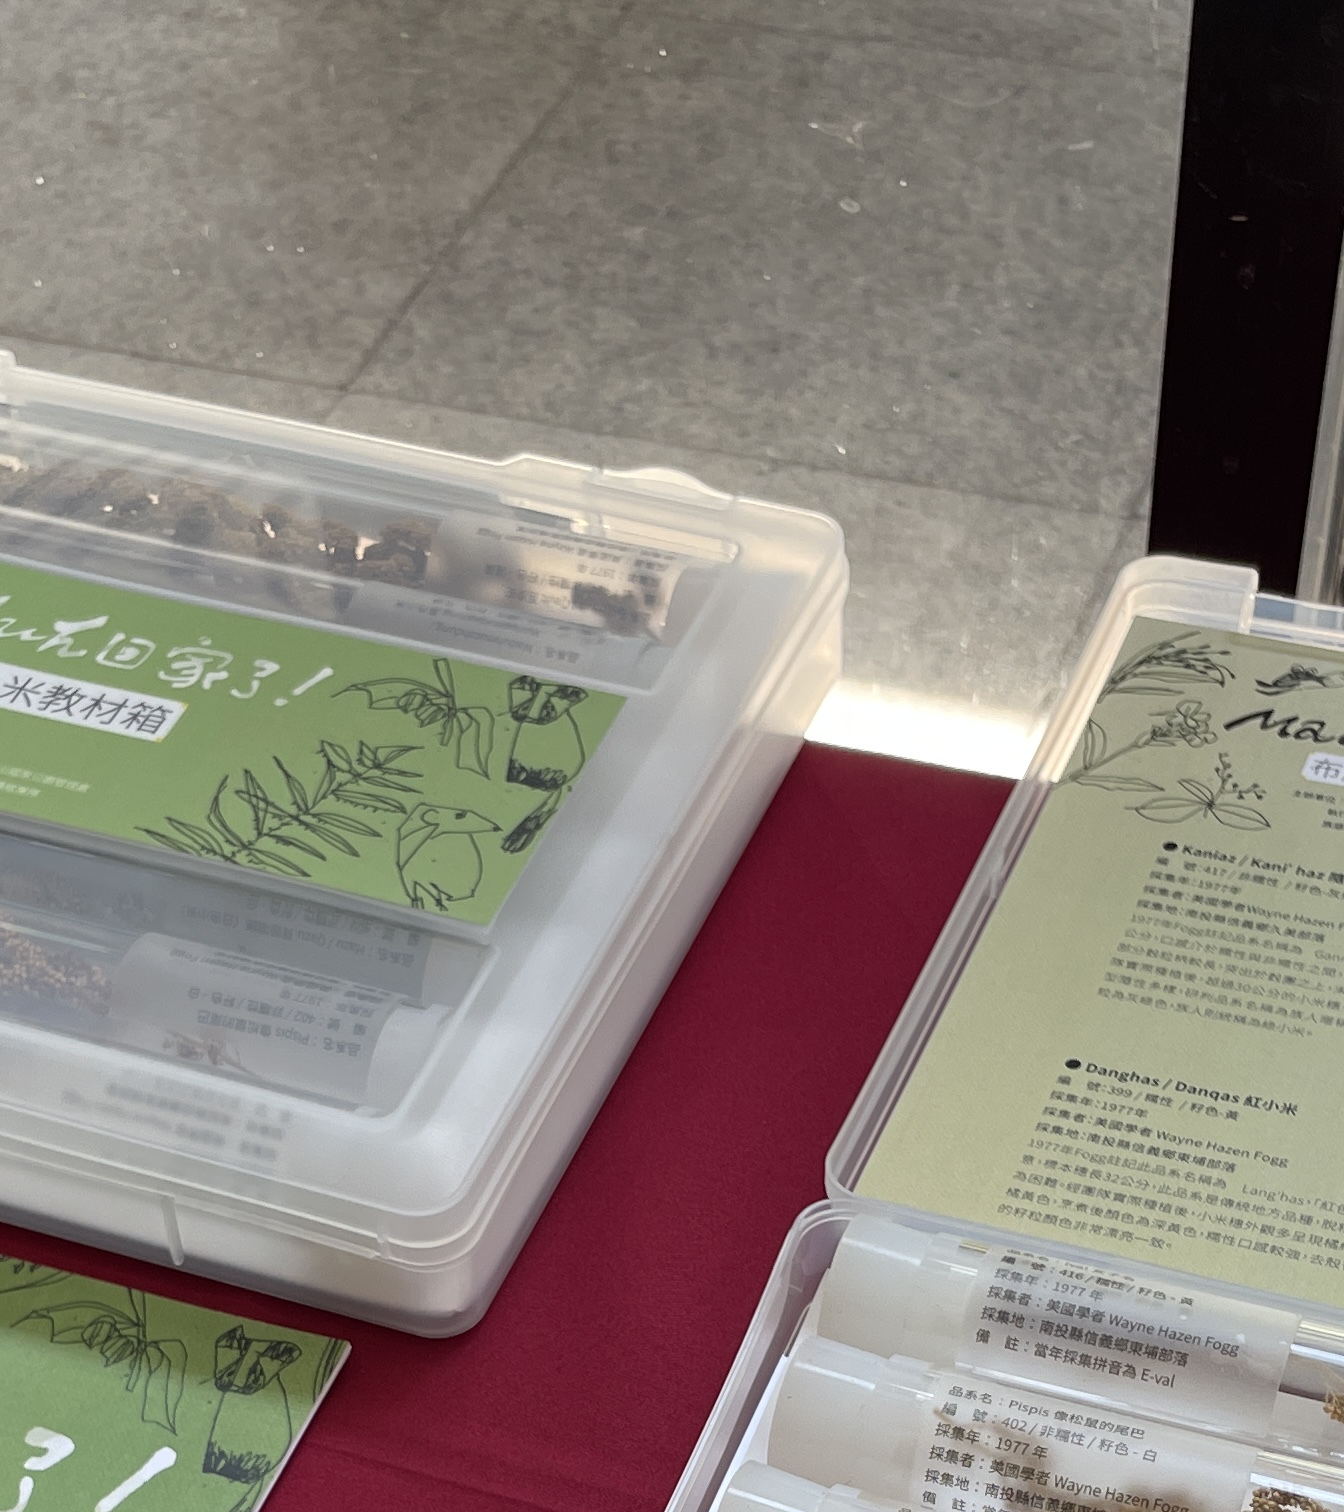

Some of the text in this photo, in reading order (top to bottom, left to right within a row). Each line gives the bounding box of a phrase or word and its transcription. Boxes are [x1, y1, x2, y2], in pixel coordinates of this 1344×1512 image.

[1083, 1060, 1299, 1117] Danghas Danqas 紅小米
[1109, 1311, 1155, 1335] Wayne
[1158, 1323, 1201, 1346] Hazen
[1205, 1335, 1239, 1358] Fogg
[1141, 1367, 1176, 1388] E-val
[1054, 1409, 1145, 1440] 像松鼠的尾巴
[1143, 1449, 1157, 1462] 白
[1055, 1474, 1102, 1498] Wayne
[1105, 1485, 1149, 1508] Hazen
